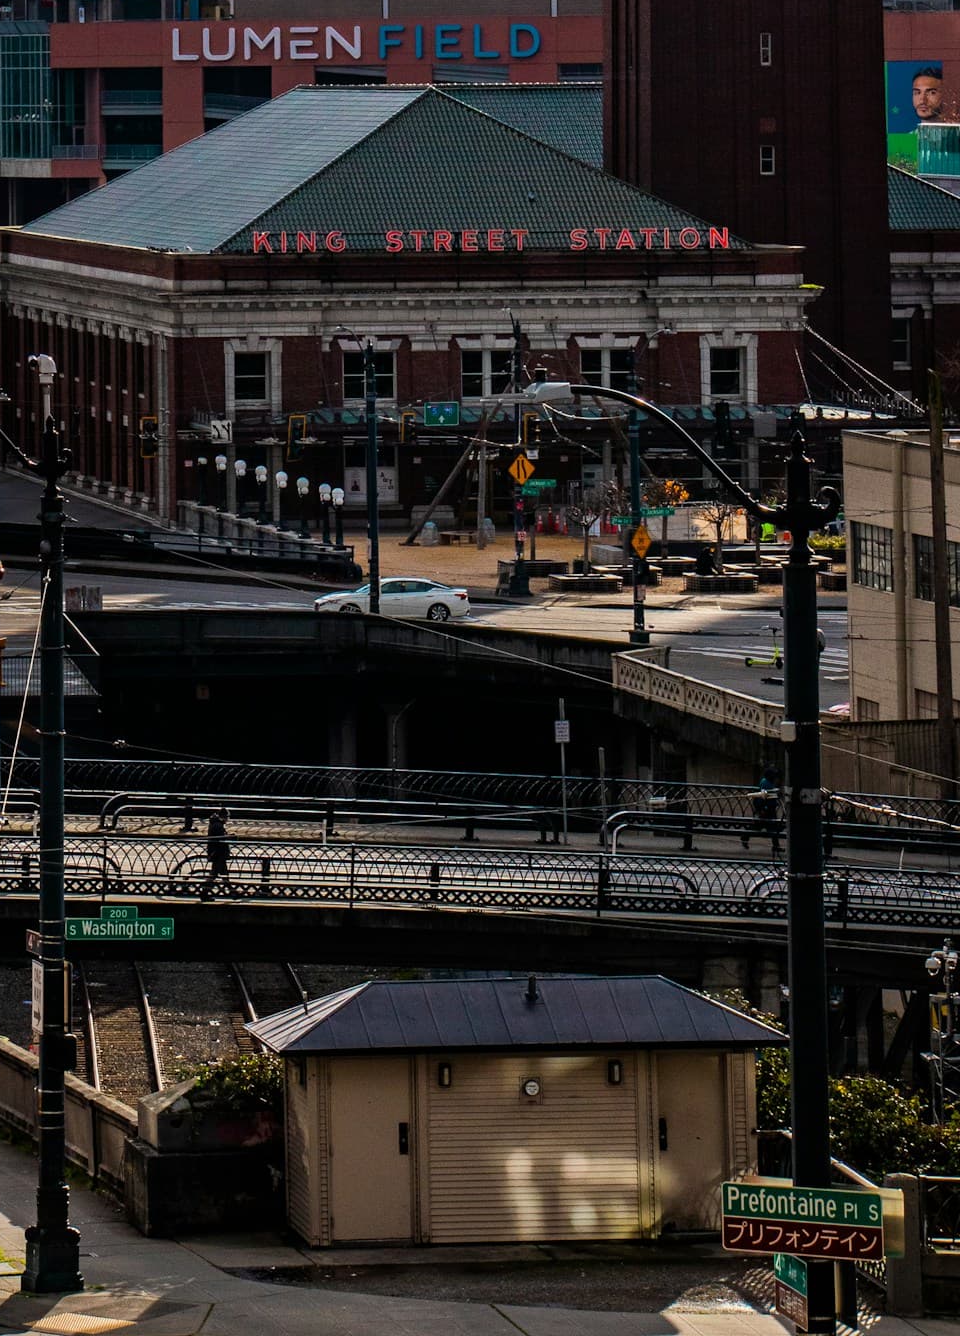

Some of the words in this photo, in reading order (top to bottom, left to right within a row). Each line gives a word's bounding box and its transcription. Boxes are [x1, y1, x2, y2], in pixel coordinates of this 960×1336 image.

[171, 25, 361, 61] LUMEN
[378, 24, 541, 60] FIELD
[253, 230, 347, 254] KING
[385, 228, 530, 253] STREET
[569, 227, 730, 251] STATION
[110, 909, 128, 918] 200
[81, 920, 155, 939] Washington
[727, 1186, 837, 1218] Prefontaine
[843, 1202, 858, 1220] Pl
[868, 1204, 879, 1221] S
[727, 1220, 878, 1253] プリフォンテイン
